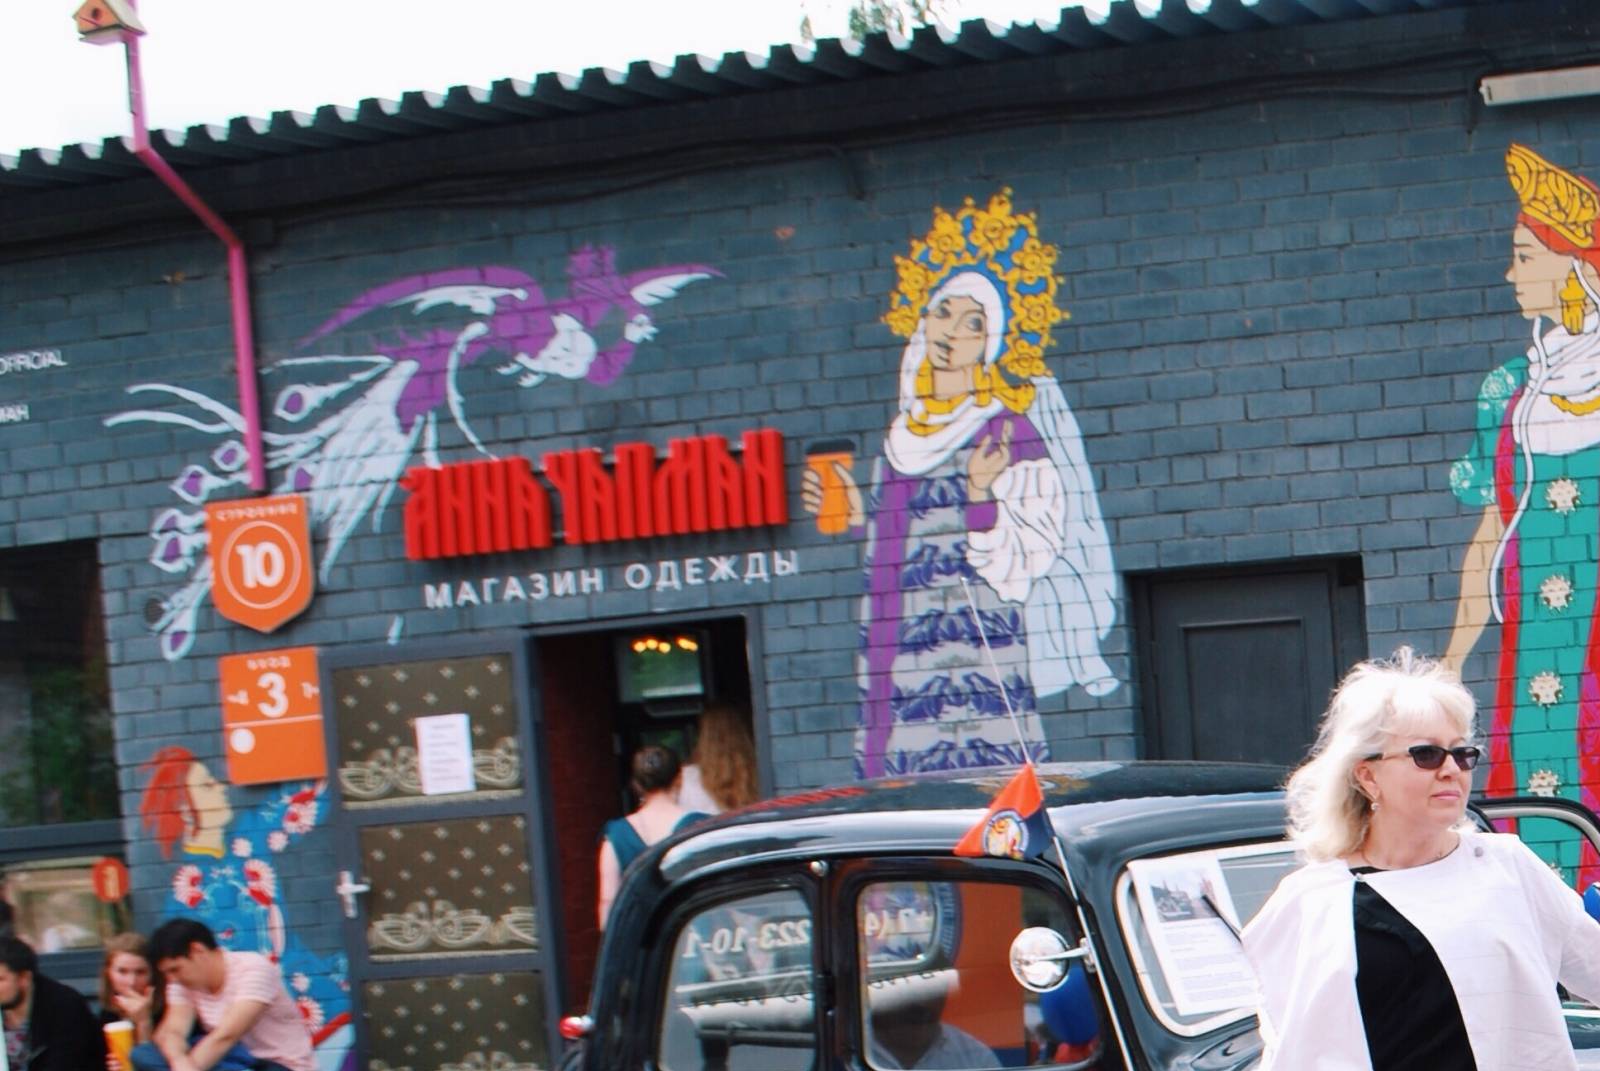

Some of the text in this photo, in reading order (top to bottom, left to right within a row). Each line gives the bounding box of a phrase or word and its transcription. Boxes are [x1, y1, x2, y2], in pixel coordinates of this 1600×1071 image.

[236, 541, 285, 588] 10
[424, 549, 799, 609] МАГАЗИН ОДЕЖДЫ
[257, 672, 289, 718] 3
